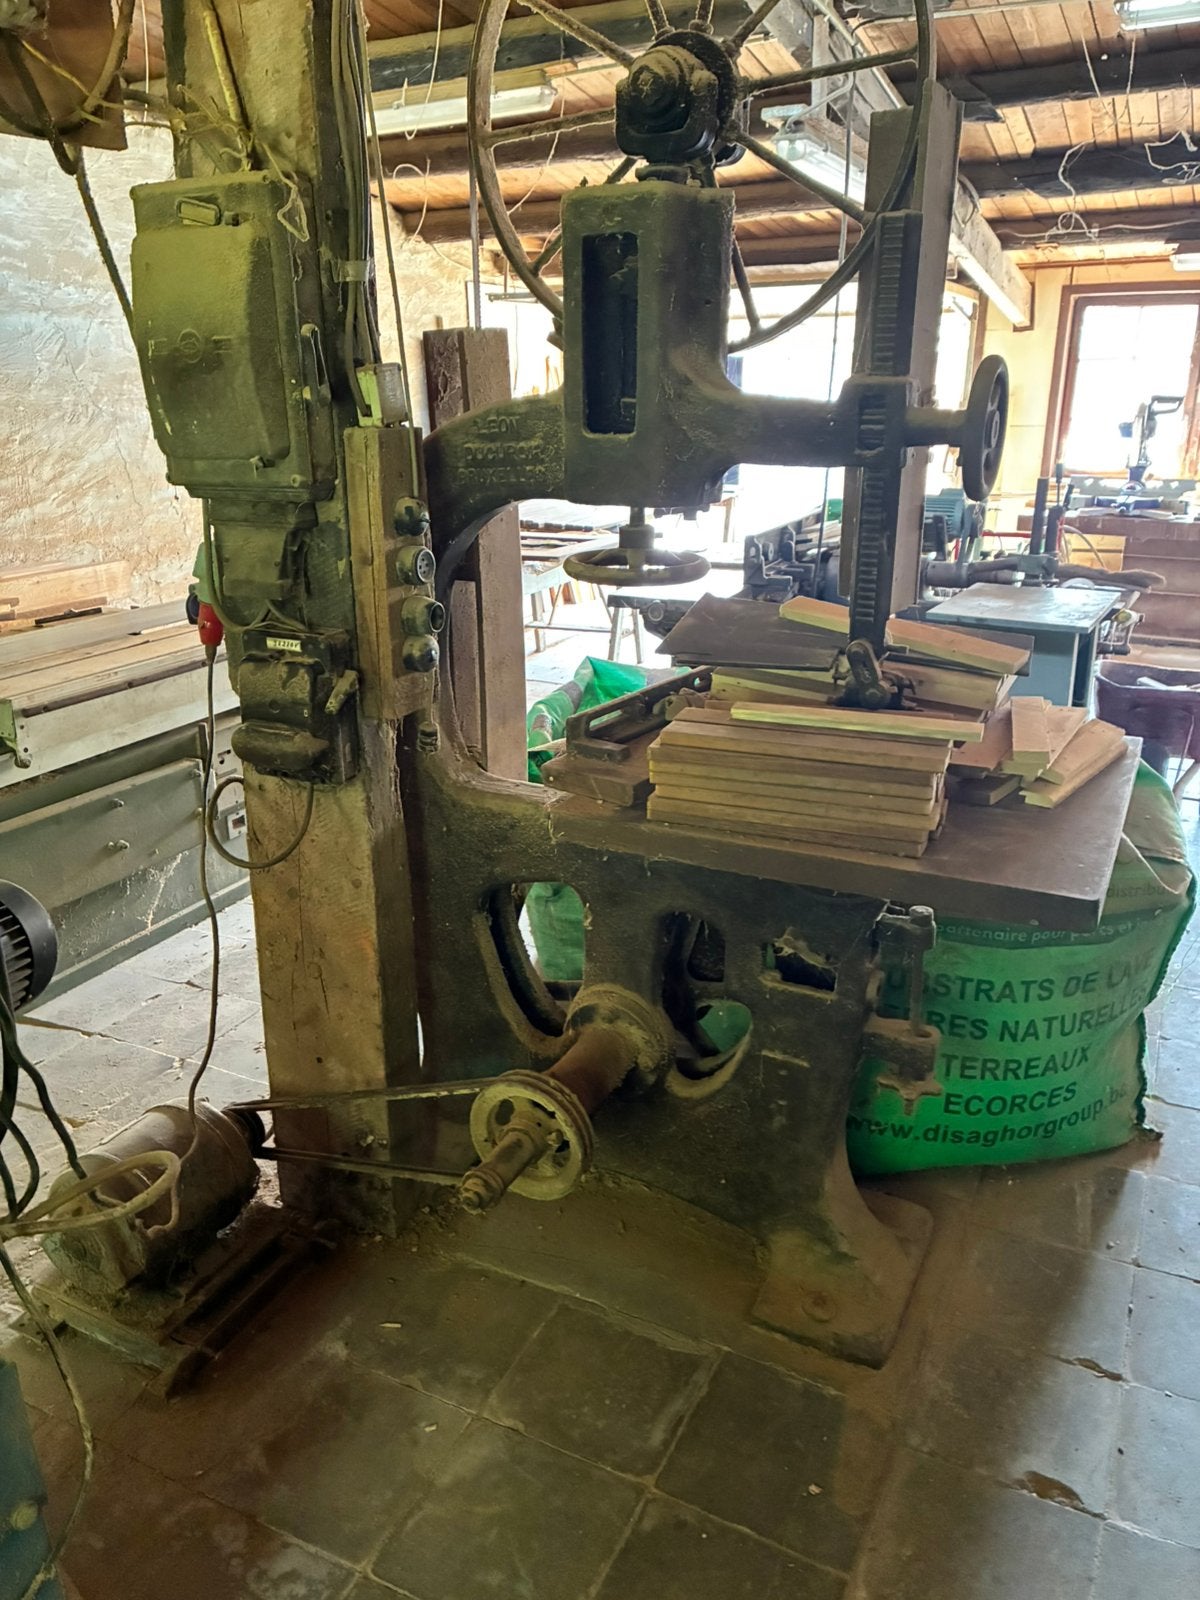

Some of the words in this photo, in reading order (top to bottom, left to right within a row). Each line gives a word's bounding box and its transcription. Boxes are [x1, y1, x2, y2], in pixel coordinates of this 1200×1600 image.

[1031, 929, 1066, 944] pour
[1062, 970, 1100, 999] DE
[999, 987, 1147, 1043] NATURELLES
[942, 1044, 1092, 1082] TERREAUX
[943, 1081, 1079, 1116] ECORCES
